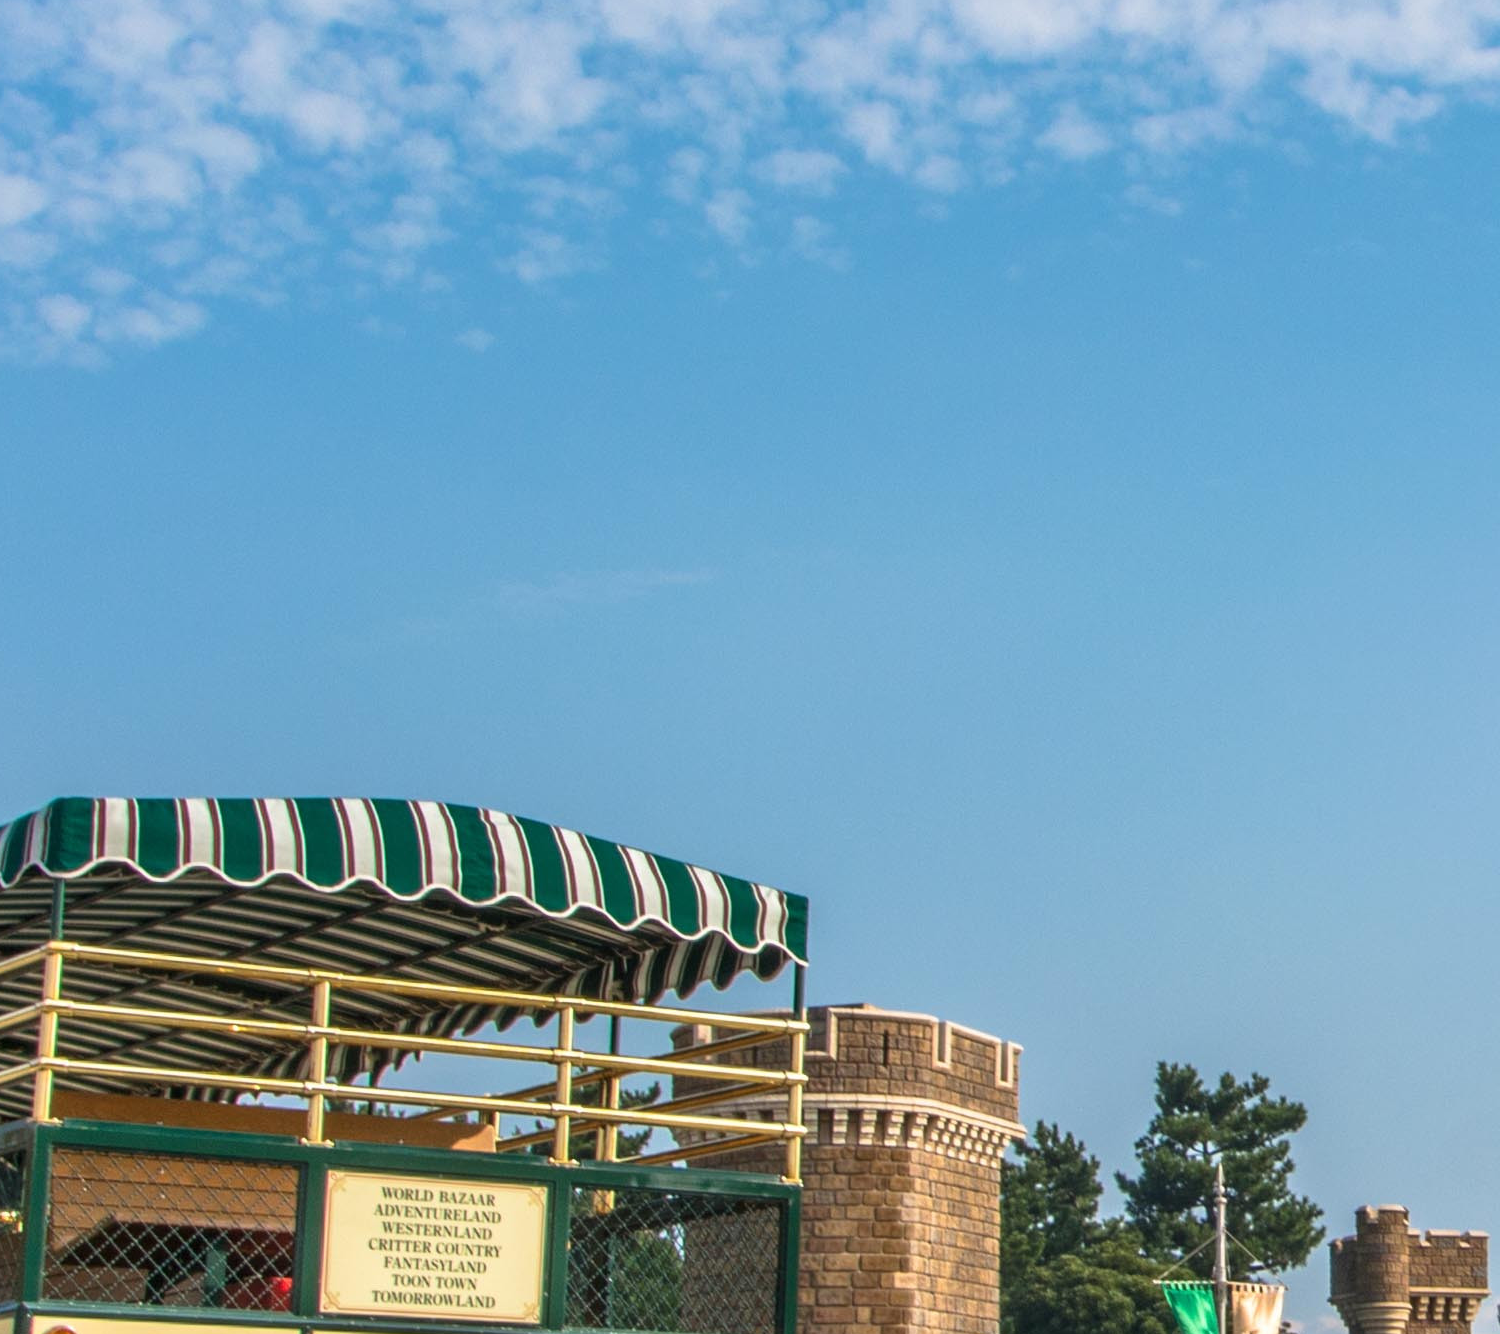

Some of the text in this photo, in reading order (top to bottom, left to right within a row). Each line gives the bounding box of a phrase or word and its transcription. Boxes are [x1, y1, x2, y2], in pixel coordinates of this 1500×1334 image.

[381, 1186, 496, 1207] WORLD BAZAAR
[374, 1203, 502, 1224] ADVENTURELAND
[382, 1221, 493, 1241] WESTERNLAND
[368, 1238, 502, 1258] CRITTER COUNTRY
[384, 1256, 487, 1275] FANTASYLAND
[392, 1273, 478, 1291] TOON TOWN
[372, 1290, 496, 1309] TOMORROWLAND
